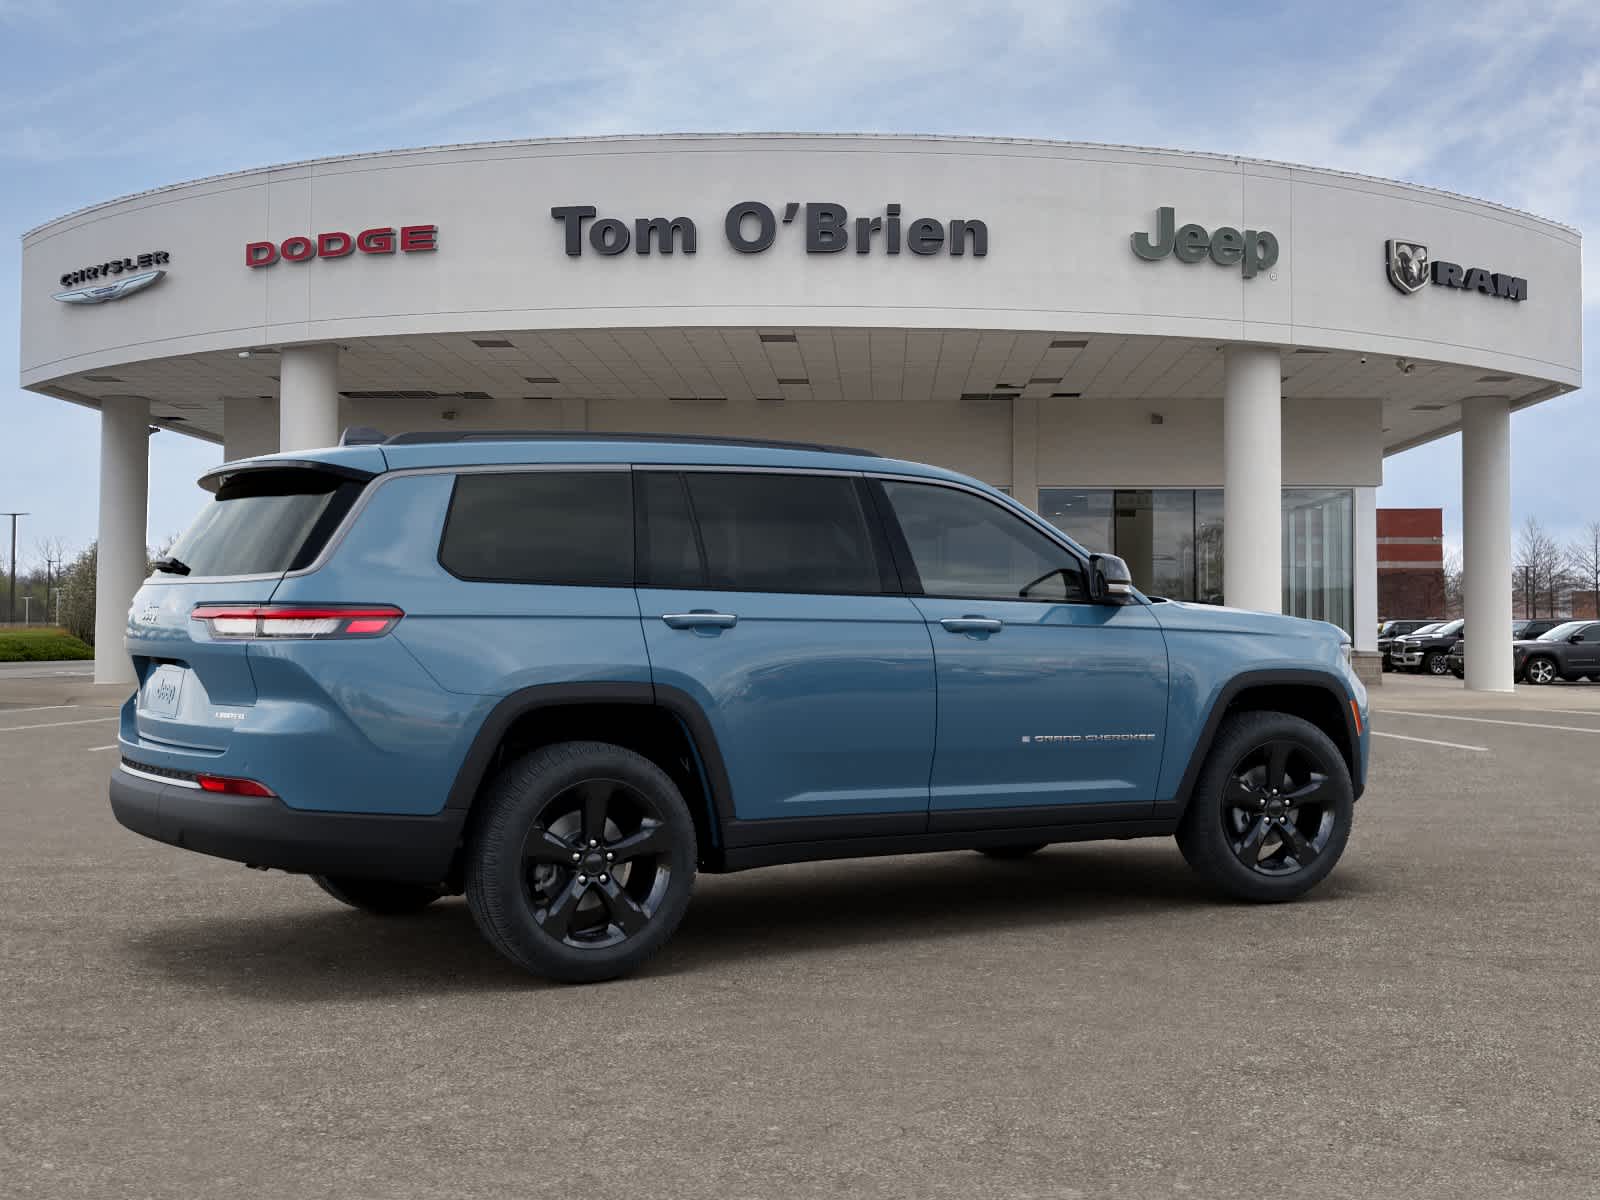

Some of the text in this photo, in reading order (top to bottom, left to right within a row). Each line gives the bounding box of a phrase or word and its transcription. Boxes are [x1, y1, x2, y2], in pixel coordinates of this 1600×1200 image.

[245, 225, 438, 269] DODGE
[551, 201, 988, 256] Tom O'Brien
[1130, 206, 1279, 279] Jeep
[60, 250, 170, 288] CHRYSLER
[1431, 260, 1528, 302] RAM
